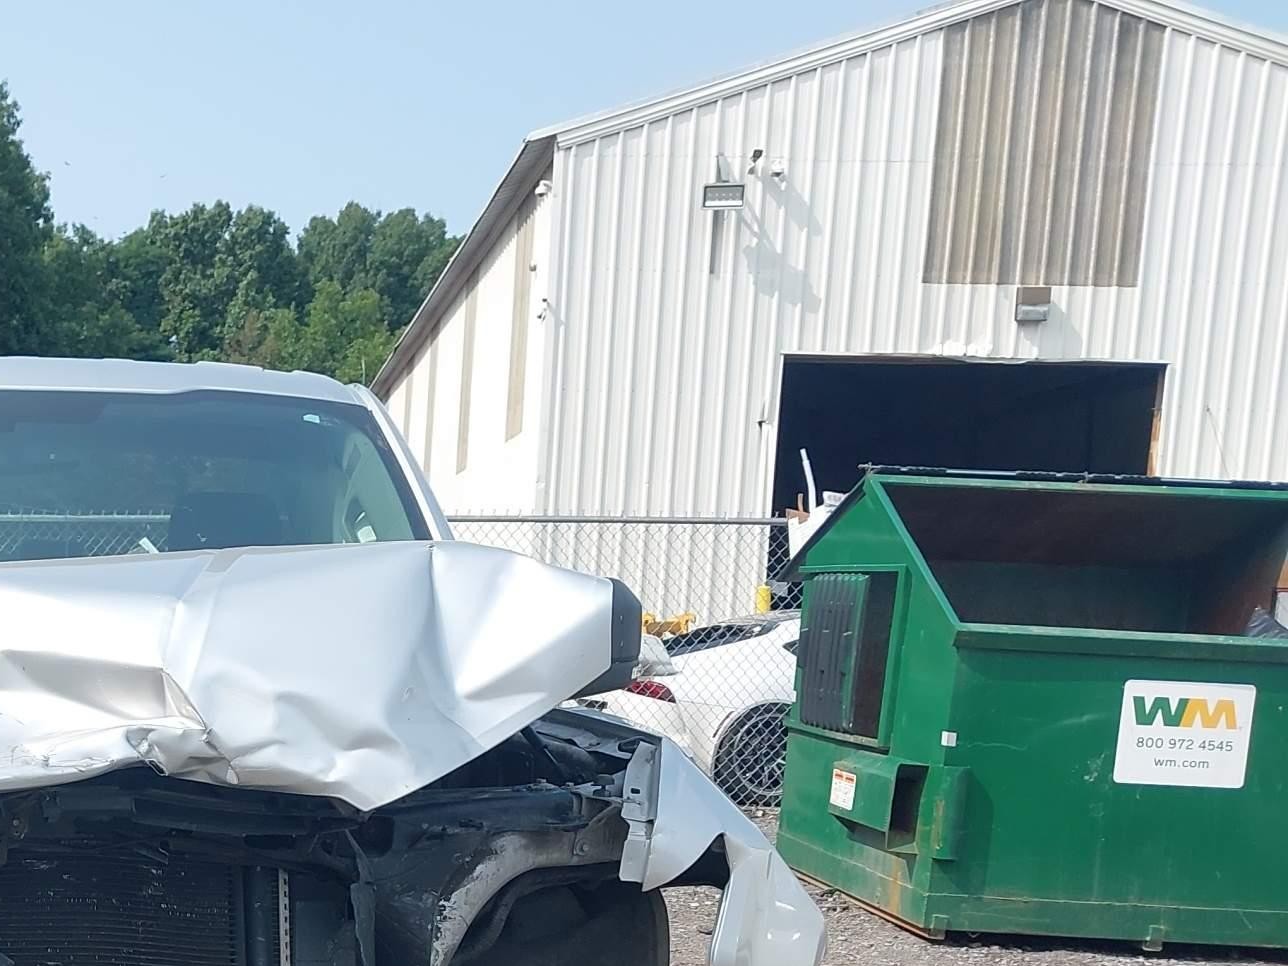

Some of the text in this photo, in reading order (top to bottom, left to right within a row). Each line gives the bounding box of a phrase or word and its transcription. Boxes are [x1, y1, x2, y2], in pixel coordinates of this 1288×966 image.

[1132, 695, 1238, 730] WM
[1136, 736, 1233, 752] 800 972 4545
[1153, 757, 1210, 769] wm.com
